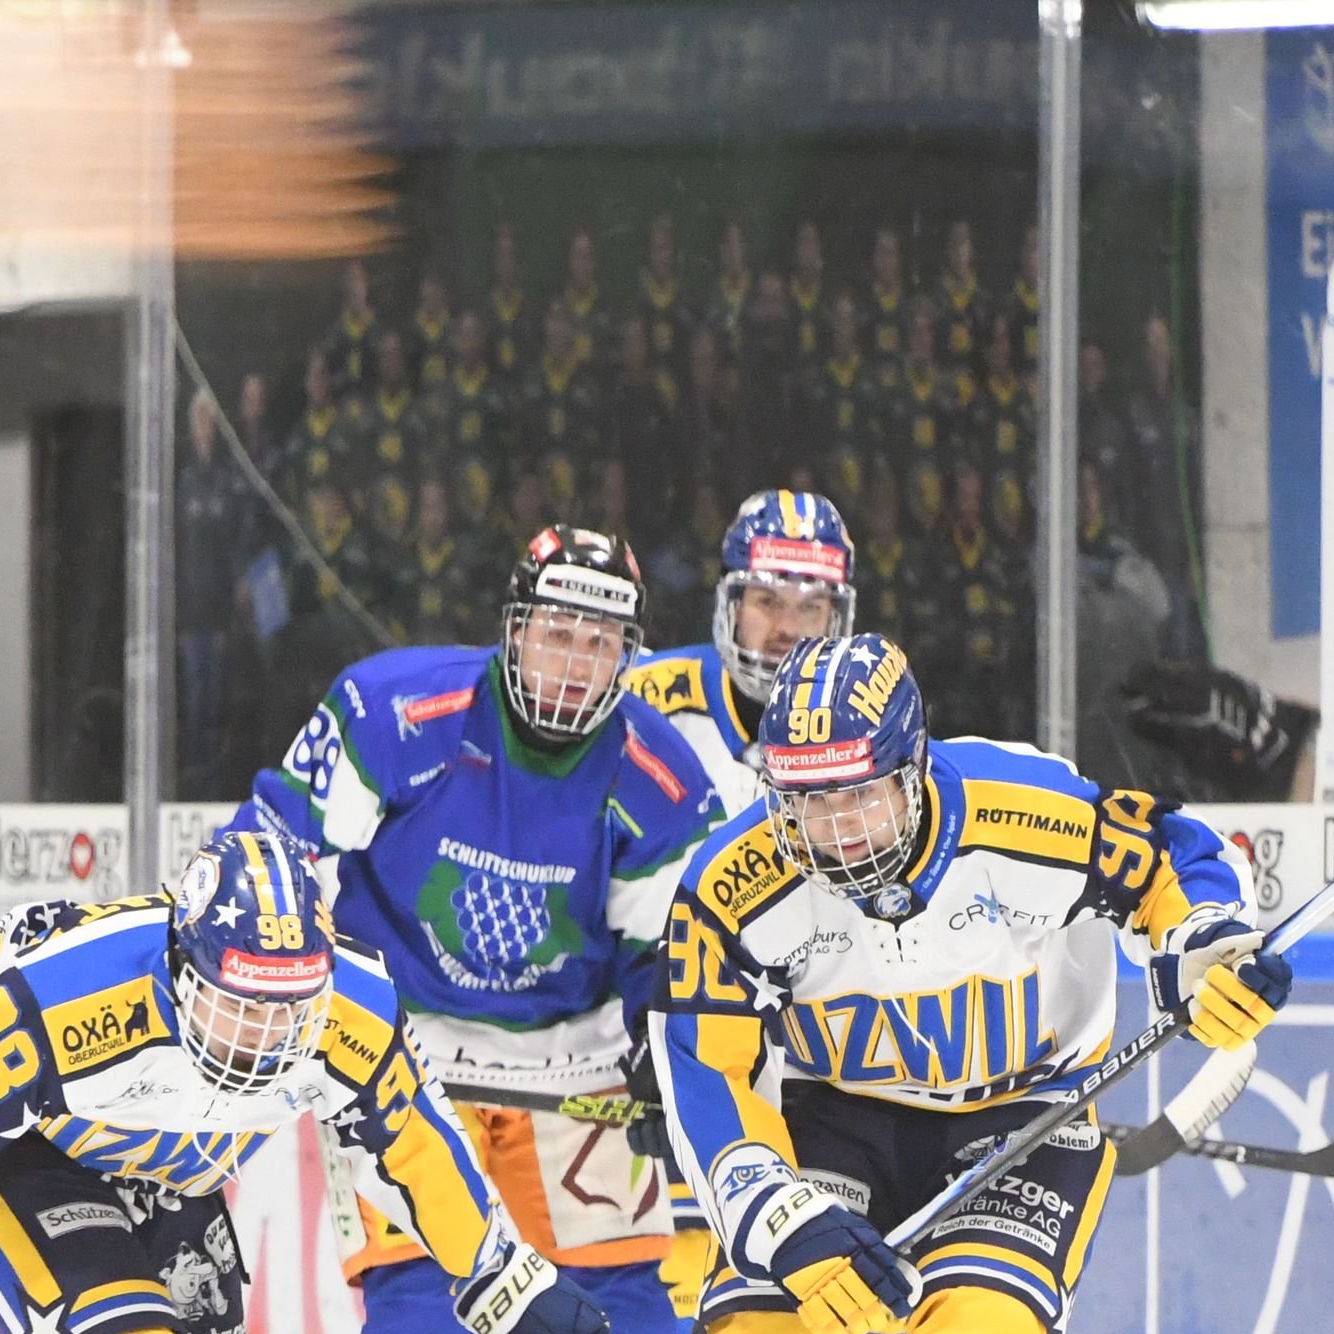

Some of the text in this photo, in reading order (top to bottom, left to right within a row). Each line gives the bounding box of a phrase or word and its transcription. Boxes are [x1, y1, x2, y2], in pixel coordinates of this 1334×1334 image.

[787, 707, 832, 745] 90
[766, 747, 854, 771] Appenzeller
[974, 807, 1089, 840] RÜTTIMANN
[712, 841, 771, 908] OXÄ
[257, 913, 305, 950] 98
[227, 955, 322, 978] Appenzeller
[62, 1004, 122, 1053] OXÄ
[781, 968, 1060, 1090] UZWIL
[67, 1037, 126, 1066] OBERUZWIL
[1048, 1132, 1095, 1149] oblem!
[960, 1192, 1062, 1240] tränke AG
[968, 1216, 989, 1228] der
[993, 1220, 1052, 1250] Getränke
